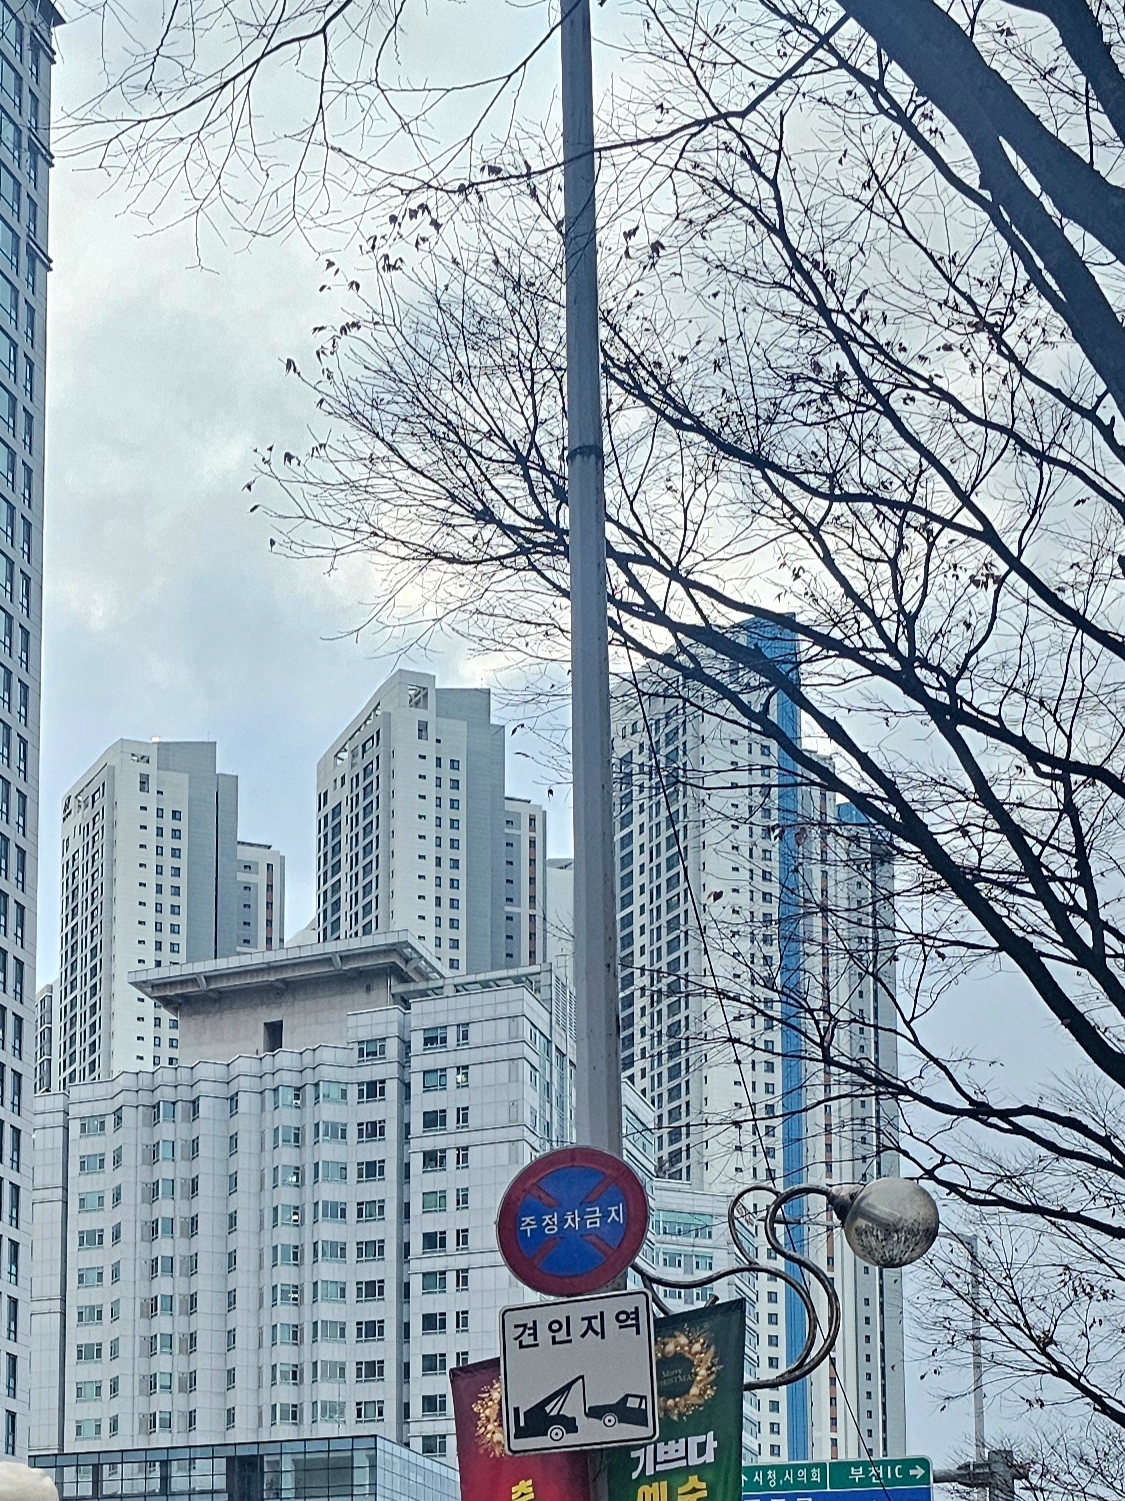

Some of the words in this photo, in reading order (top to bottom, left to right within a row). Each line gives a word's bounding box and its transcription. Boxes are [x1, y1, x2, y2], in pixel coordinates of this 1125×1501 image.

[519, 1202, 624, 1238] 주정차금지
[513, 1306, 641, 1350] 견인지역
[630, 1431, 718, 1480] 기쁘다
